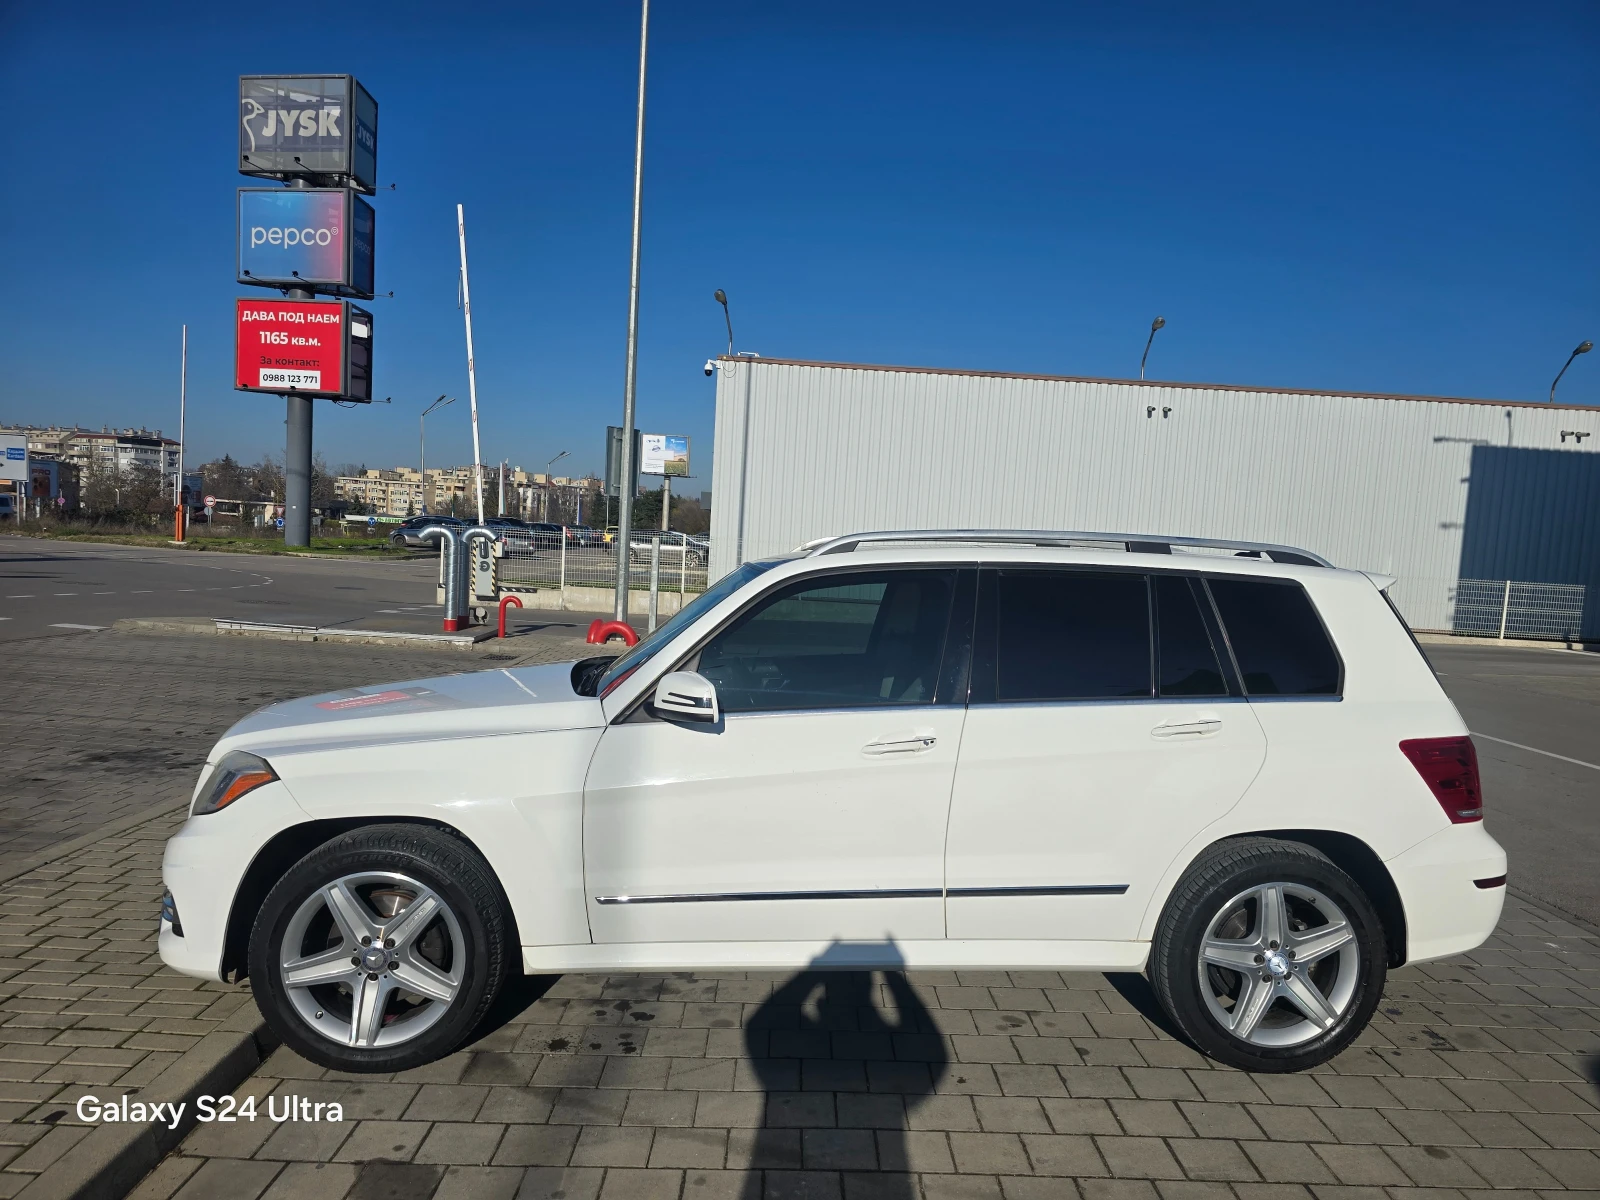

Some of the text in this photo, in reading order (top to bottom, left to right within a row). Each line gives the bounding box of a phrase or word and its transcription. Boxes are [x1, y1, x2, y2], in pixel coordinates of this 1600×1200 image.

[262, 109, 341, 137] JYSK
[357, 125, 375, 150] JYSK
[251, 226, 331, 249] pepco
[353, 237, 371, 255] pepco
[242, 310, 340, 324] ДАВА ПОД НАЕМ
[259, 331, 321, 347] 1165 кв.м.
[259, 356, 320, 367] За контакт:
[262, 373, 318, 384] 0988 123 771
[341, 853, 414, 867] MICHELIN
